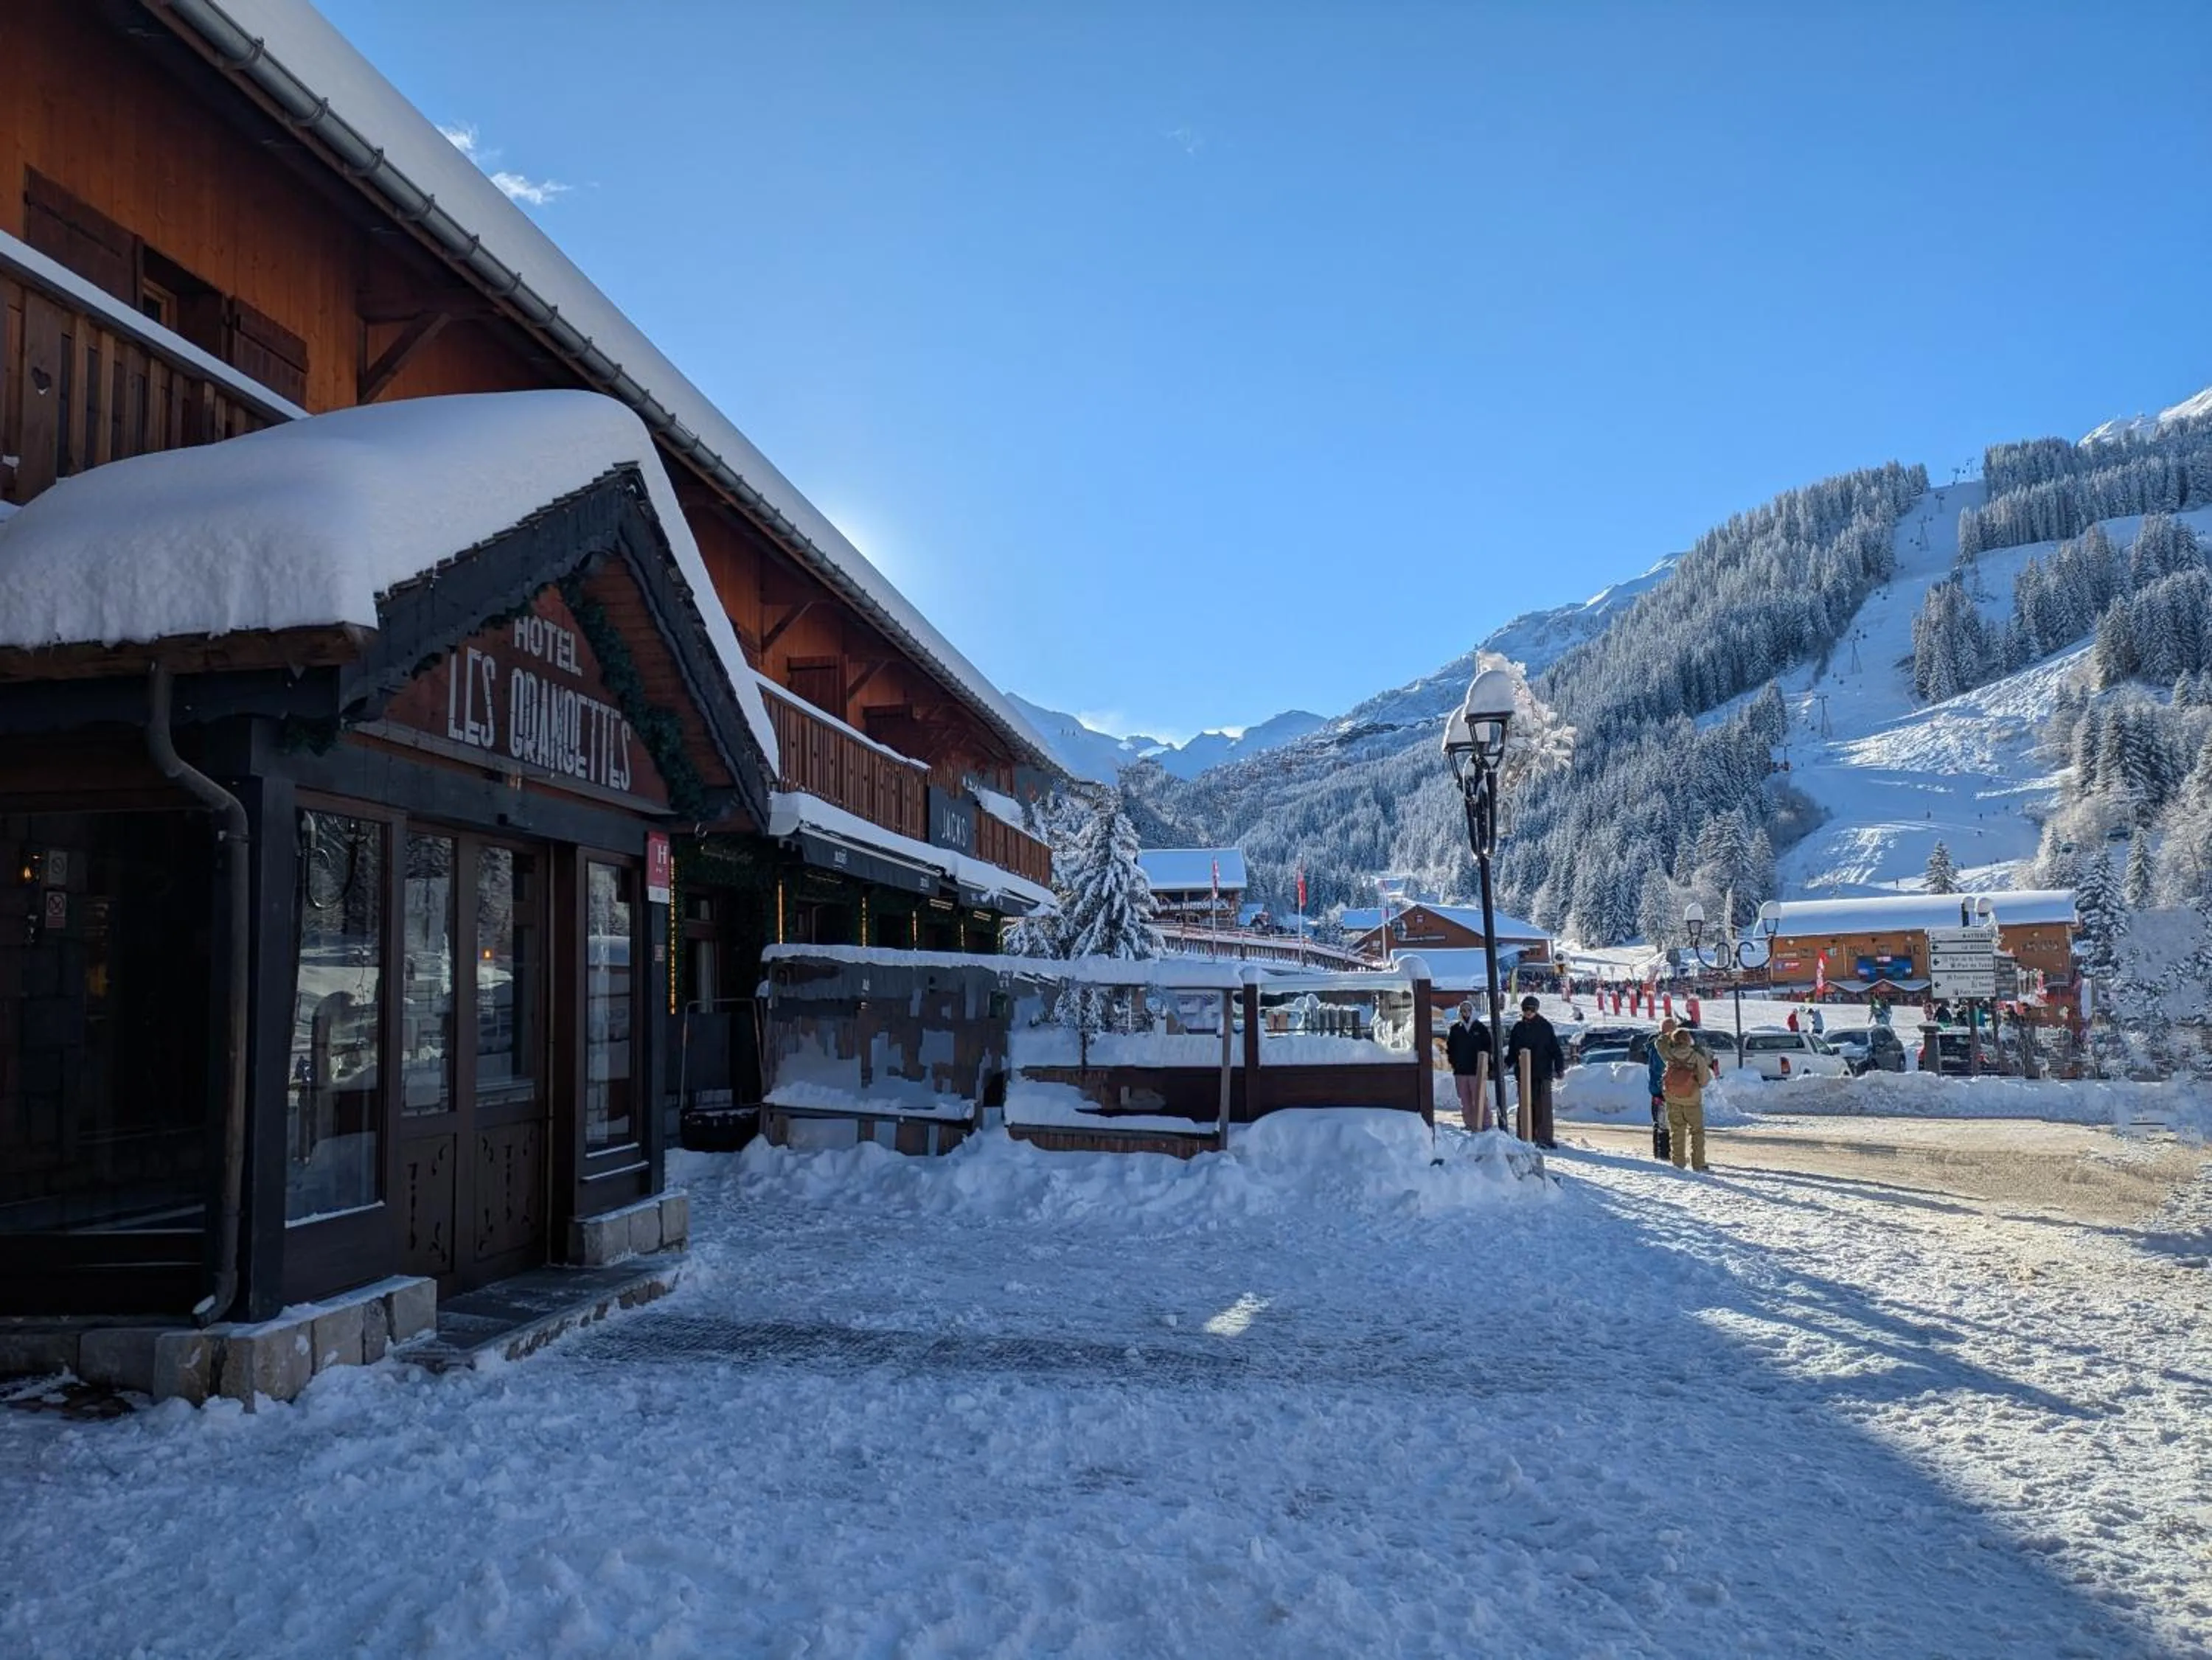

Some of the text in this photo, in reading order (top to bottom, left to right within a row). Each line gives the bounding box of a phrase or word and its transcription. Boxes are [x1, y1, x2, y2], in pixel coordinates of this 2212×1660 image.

[514, 615, 582, 677] HOTEL
[448, 646, 631, 791] LES GRANGETTES
[657, 844, 668, 865] H
